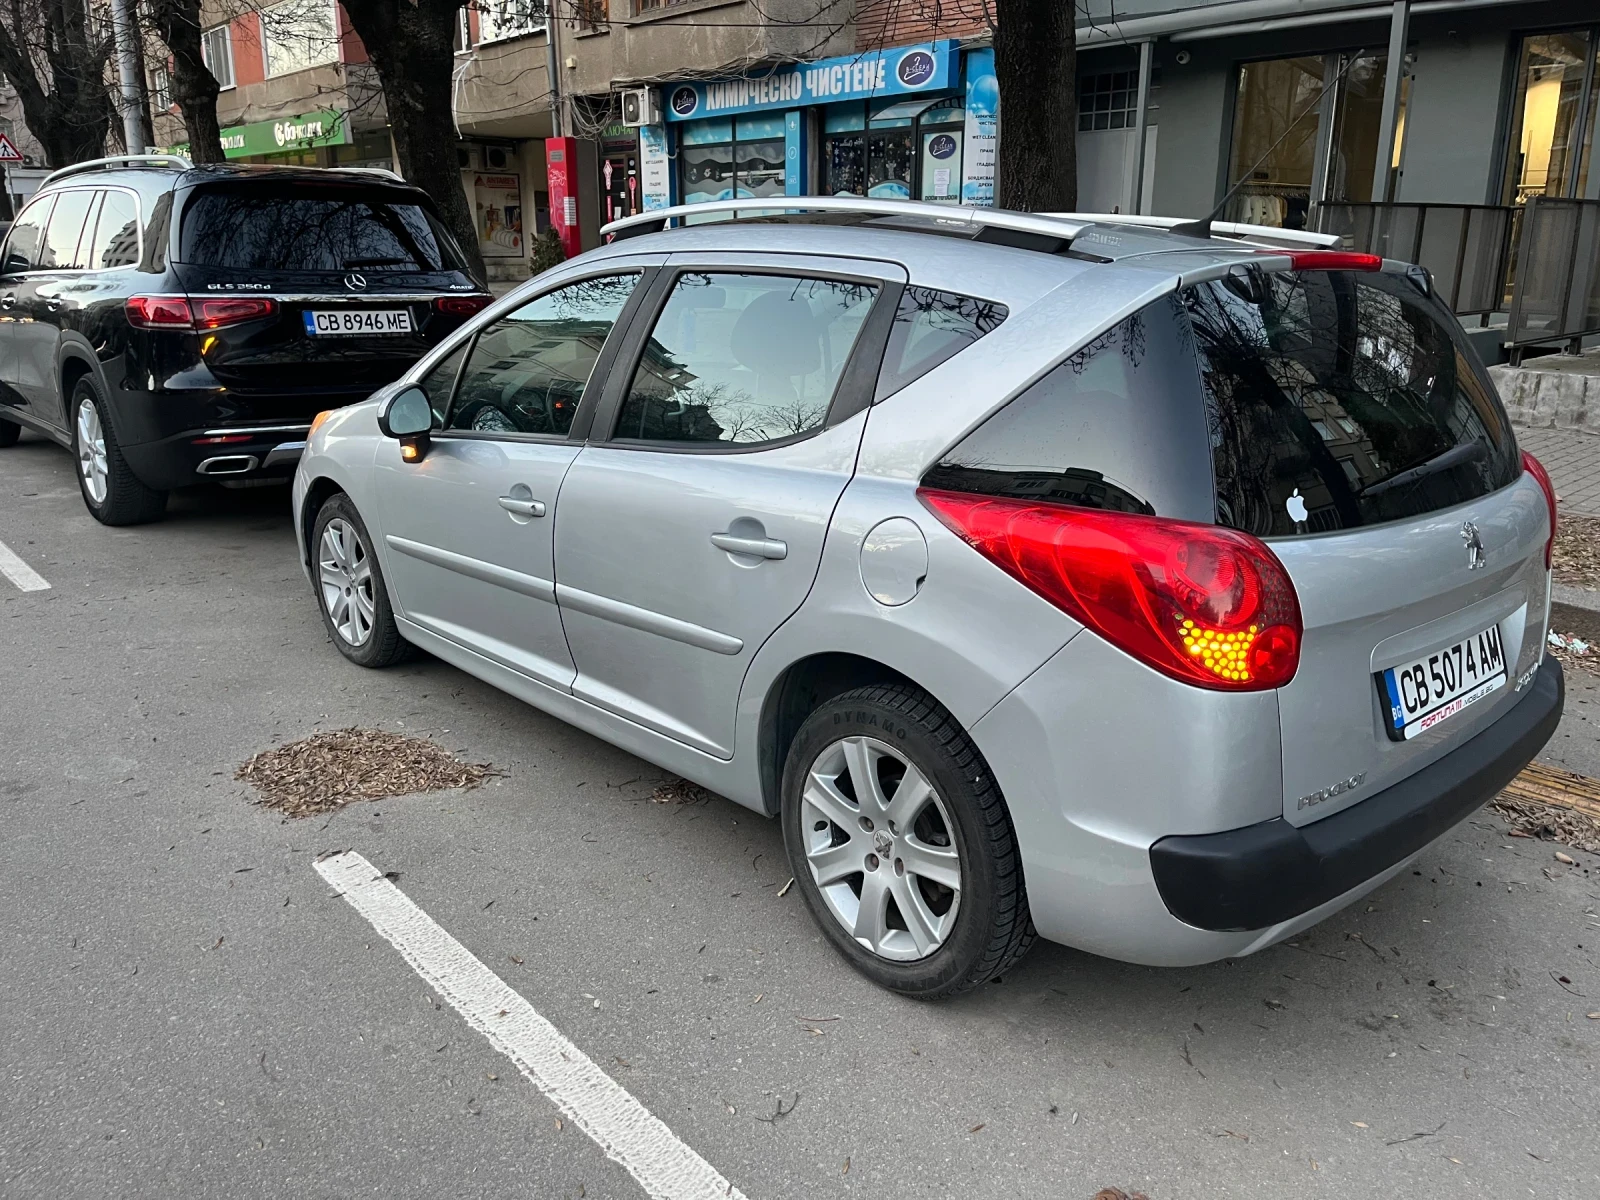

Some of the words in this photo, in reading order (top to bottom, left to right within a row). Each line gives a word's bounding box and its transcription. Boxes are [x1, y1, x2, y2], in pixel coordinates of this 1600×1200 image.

[706, 71, 802, 111] ХИМИЧЕСКО
[806, 58, 886, 98] ЧИСТЕНЕ
[316, 313, 340, 331] CB
[343, 313, 384, 331] 8946
[386, 313, 409, 330] ME
[1400, 663, 1429, 714] CB
[1428, 639, 1478, 699] 5074
[1478, 627, 1503, 675] AM
[833, 711, 906, 739] DYNAMO
[1392, 705, 1402, 721] BG
[1297, 769, 1368, 811] PEUGEOT
